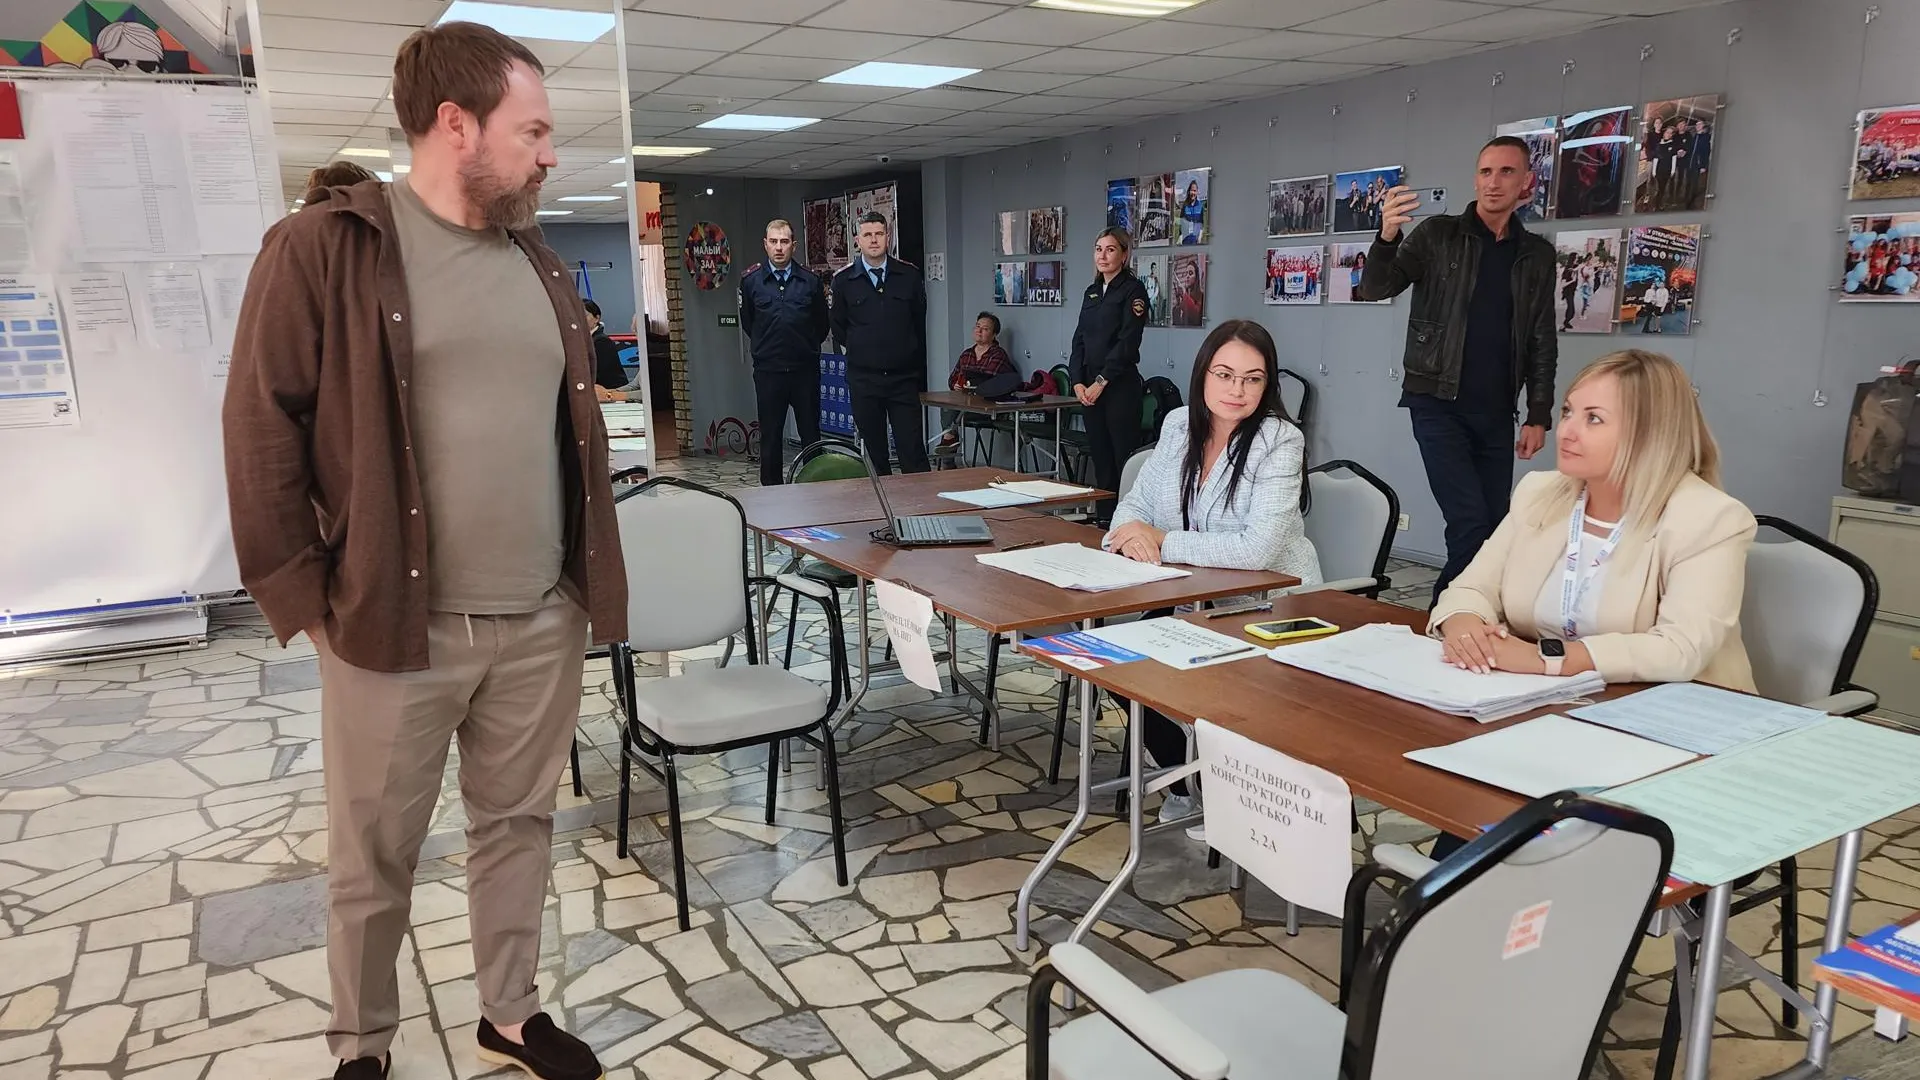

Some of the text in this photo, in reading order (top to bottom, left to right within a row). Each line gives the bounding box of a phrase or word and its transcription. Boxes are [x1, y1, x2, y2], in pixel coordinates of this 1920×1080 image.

[693, 243, 721, 255] МАЛЫЙ
[700, 260, 715, 269] ЗАЛ
[1029, 288, 1061, 303] ИСТРА
[1224, 754, 1311, 800] УЛ. ГЛАВНОГО
[1210, 763, 1328, 826] КОНСТРУКТОРА В.И.
[1238, 794, 1291, 827] АДАСЬКО
[1249, 828, 1278, 853] 2, 2А
